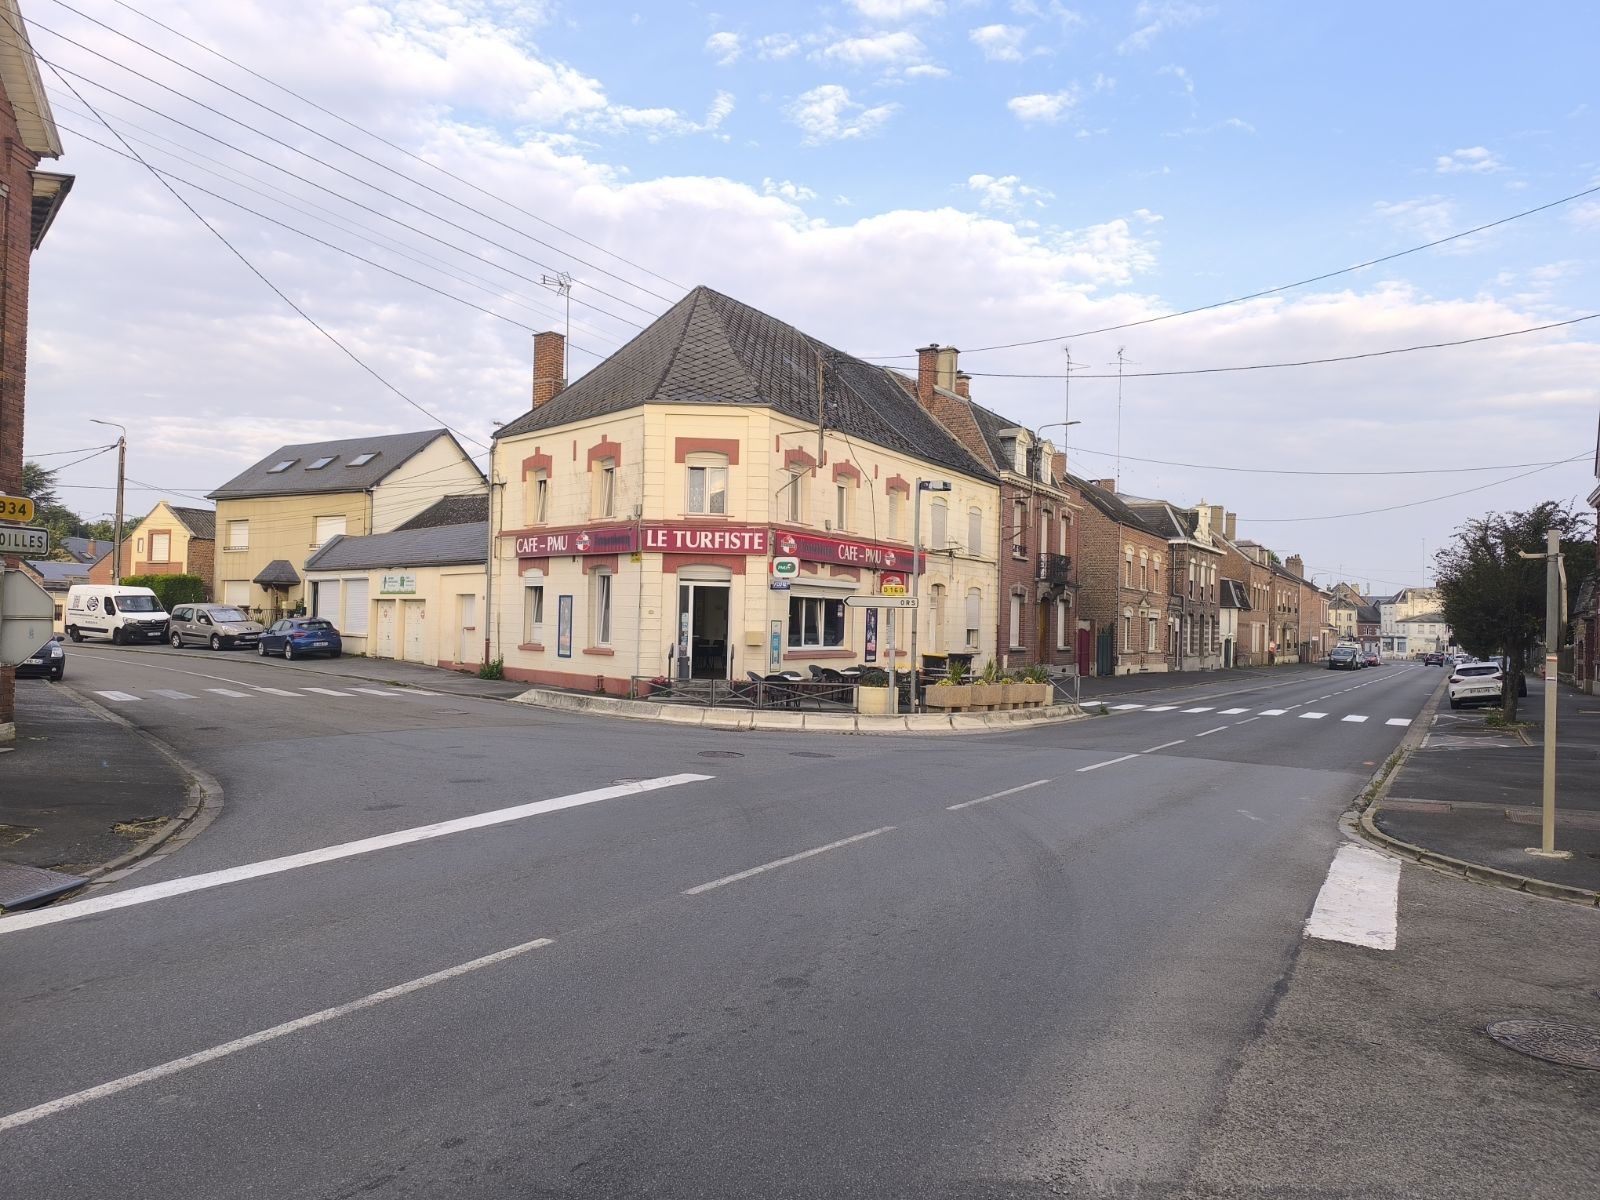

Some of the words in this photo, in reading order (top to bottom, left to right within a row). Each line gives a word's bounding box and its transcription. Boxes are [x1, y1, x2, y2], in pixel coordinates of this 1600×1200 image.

[516, 537, 538, 553] CAFE
[547, 535, 568, 552] PMU
[646, 530, 668, 547] LE
[673, 530, 764, 550] TURFISTE
[838, 544, 858, 561] CAFE
[865, 548, 882, 564] PMU
